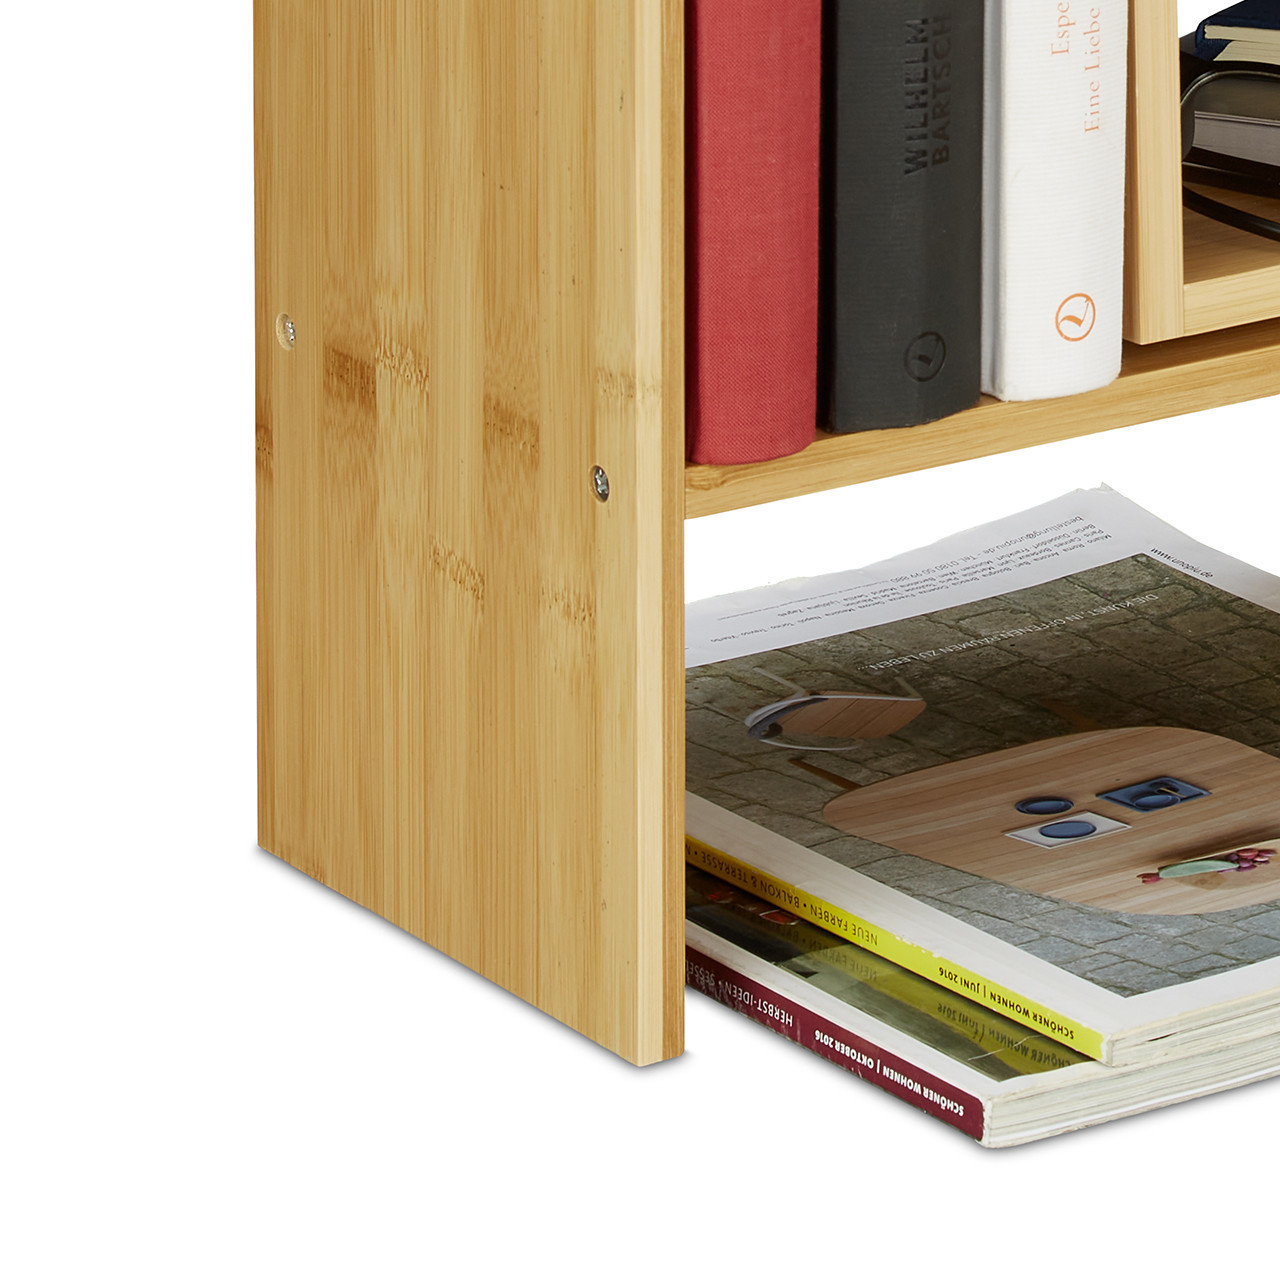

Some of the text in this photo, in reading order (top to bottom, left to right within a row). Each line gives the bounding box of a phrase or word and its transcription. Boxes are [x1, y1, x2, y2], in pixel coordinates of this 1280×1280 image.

[1083, 7, 1100, 72] Liebe
[904, 18, 929, 176] WILHELM
[931, 15, 953, 165] BARTSCH
[1084, 80, 1100, 133] Eine
[1132, 592, 1158, 604] DIE
[997, 618, 1066, 640] OFFENEN
[918, 649, 940, 659] ZU
[701, 851, 747, 883] TERRASSE
[751, 876, 757, 887] &
[760, 881, 800, 908] BALKON
[810, 904, 848, 931] FARBEN
[851, 923, 877, 946] NEUE
[725, 981, 793, 1027] HERBST-IDEEN
[938, 967, 1074, 1040] SCHÖNER WOHNEN JUNI 2016
[814, 1030, 964, 1116] SCHÖNER WOHNEN OKTOBER 2016
